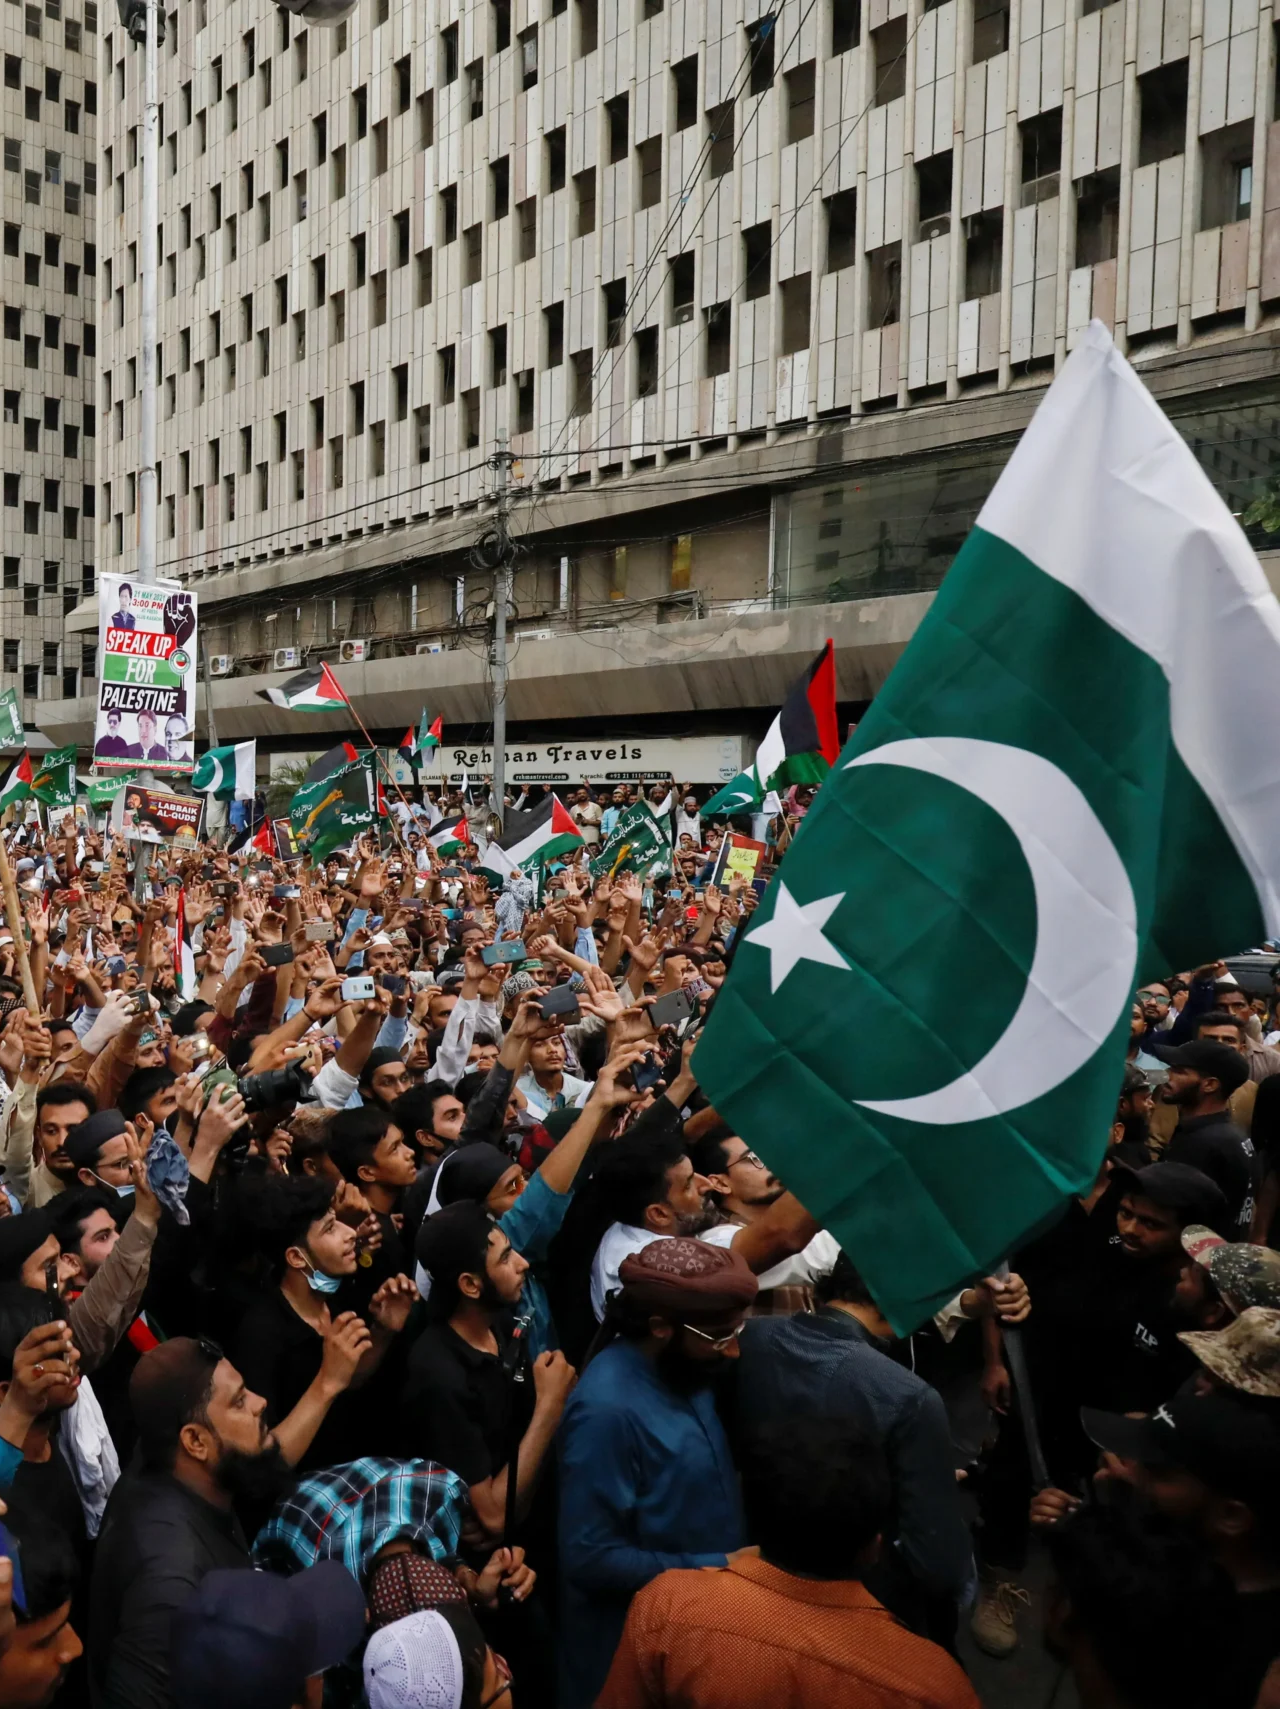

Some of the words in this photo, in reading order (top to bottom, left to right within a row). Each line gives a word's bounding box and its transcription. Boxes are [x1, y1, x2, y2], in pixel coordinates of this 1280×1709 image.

[142, 591, 153, 599] MAY
[132, 598, 149, 608] 3:00
[152, 602, 164, 610] PM
[106, 630, 151, 654] SPEAK
[154, 636, 172, 656] UP
[125, 658, 156, 684] FOR
[102, 686, 178, 712] PALESTINE
[546, 744, 642, 764] Travels
[156, 810, 197, 822] AL-QUDS
[158, 802, 198, 815] LABBAIK
